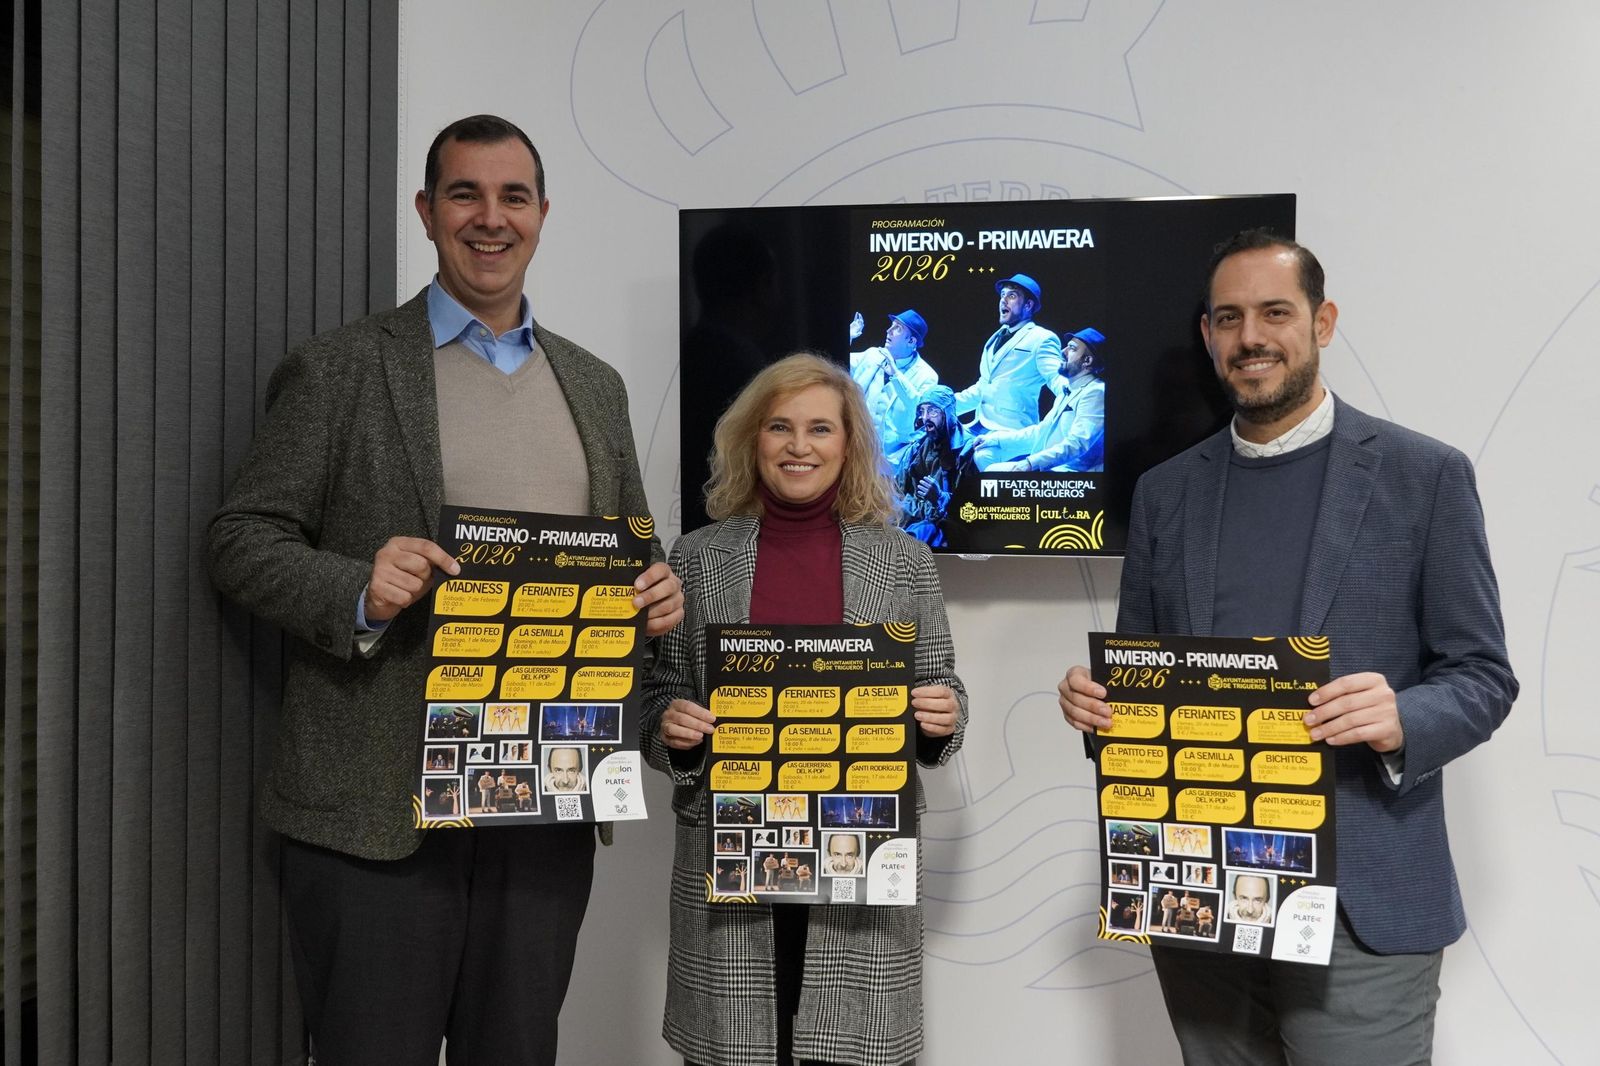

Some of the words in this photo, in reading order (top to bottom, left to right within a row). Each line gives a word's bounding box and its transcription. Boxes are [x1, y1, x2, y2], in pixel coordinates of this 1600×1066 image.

[872, 218, 945, 229] PROGRAMACIÓN
[870, 231, 964, 253] INVIERNO
[978, 228, 1095, 251] PRIMAVERA
[870, 254, 956, 282] 2026
[999, 480, 1039, 489] TEATRO
[1041, 480, 1096, 490] MUNICIPAL
[1012, 489, 1026, 498] DE
[1028, 489, 1085, 498] TRIGUEROS
[978, 506, 1031, 514] AYUNTAMIENTO
[458, 513, 518, 525] PROGRAMACIÓN
[990, 513, 1031, 521] TRIGUEROS
[455, 524, 529, 544] INVIERNO
[539, 530, 619, 548] PRIMAVERA
[455, 542, 522, 566] 2026
[446, 581, 503, 595] MADNESS
[522, 586, 574, 597] FERIANTES
[596, 587, 607, 597] LA
[609, 587, 635, 597] SELVA
[442, 626, 453, 634] EL
[454, 626, 482, 635] PATITO
[484, 627, 500, 636] FEO
[519, 628, 529, 637] LA
[530, 629, 564, 637] SEMILLA
[590, 630, 625, 638] BICHITOS
[721, 629, 772, 637] PROGRAMACIÓN
[720, 638, 784, 653] INVIERNO
[794, 638, 874, 653] PRIMAVERA
[1104, 639, 1160, 648] PROGRAMACIÓN
[720, 653, 780, 673] 2026
[1104, 648, 1176, 667] INVIERNO
[1186, 652, 1279, 670] PRIMAVERA
[440, 666, 484, 678] AIDALAI
[596, 669, 630, 678] RODRÍGUEZ
[1106, 666, 1171, 689] 2026
[1223, 677, 1267, 685] AYUNTAMIENTO
[717, 687, 768, 698] MADNESS
[785, 689, 836, 699] FERIANTES
[857, 688, 869, 697] LA
[871, 688, 899, 697] SELVA
[1178, 709, 1236, 721] FERIANTES
[1261, 711, 1275, 721] LA
[1278, 711, 1306, 721] SELV
[729, 727, 754, 735] PATITO
[755, 727, 770, 735] FEO
[788, 727, 798, 735] LA
[799, 727, 832, 735] SEMILLA
[859, 727, 895, 735] BICHITOS
[1106, 747, 1116, 755] EL
[1118, 747, 1146, 757] PATITO
[1147, 748, 1164, 758] FEO
[1184, 751, 1196, 759] LA
[1197, 751, 1234, 761] SEMILLA
[1265, 754, 1308, 764] BICHITOS
[721, 761, 760, 772] AIDALAI
[870, 763, 905, 772] RODRÍGUEZ
[1112, 785, 1155, 797] AIDALAI
[1197, 790, 1236, 798] GUERRERAS
[1259, 796, 1279, 804] SANTI
[1280, 796, 1322, 807] RODRÍGUEZ
